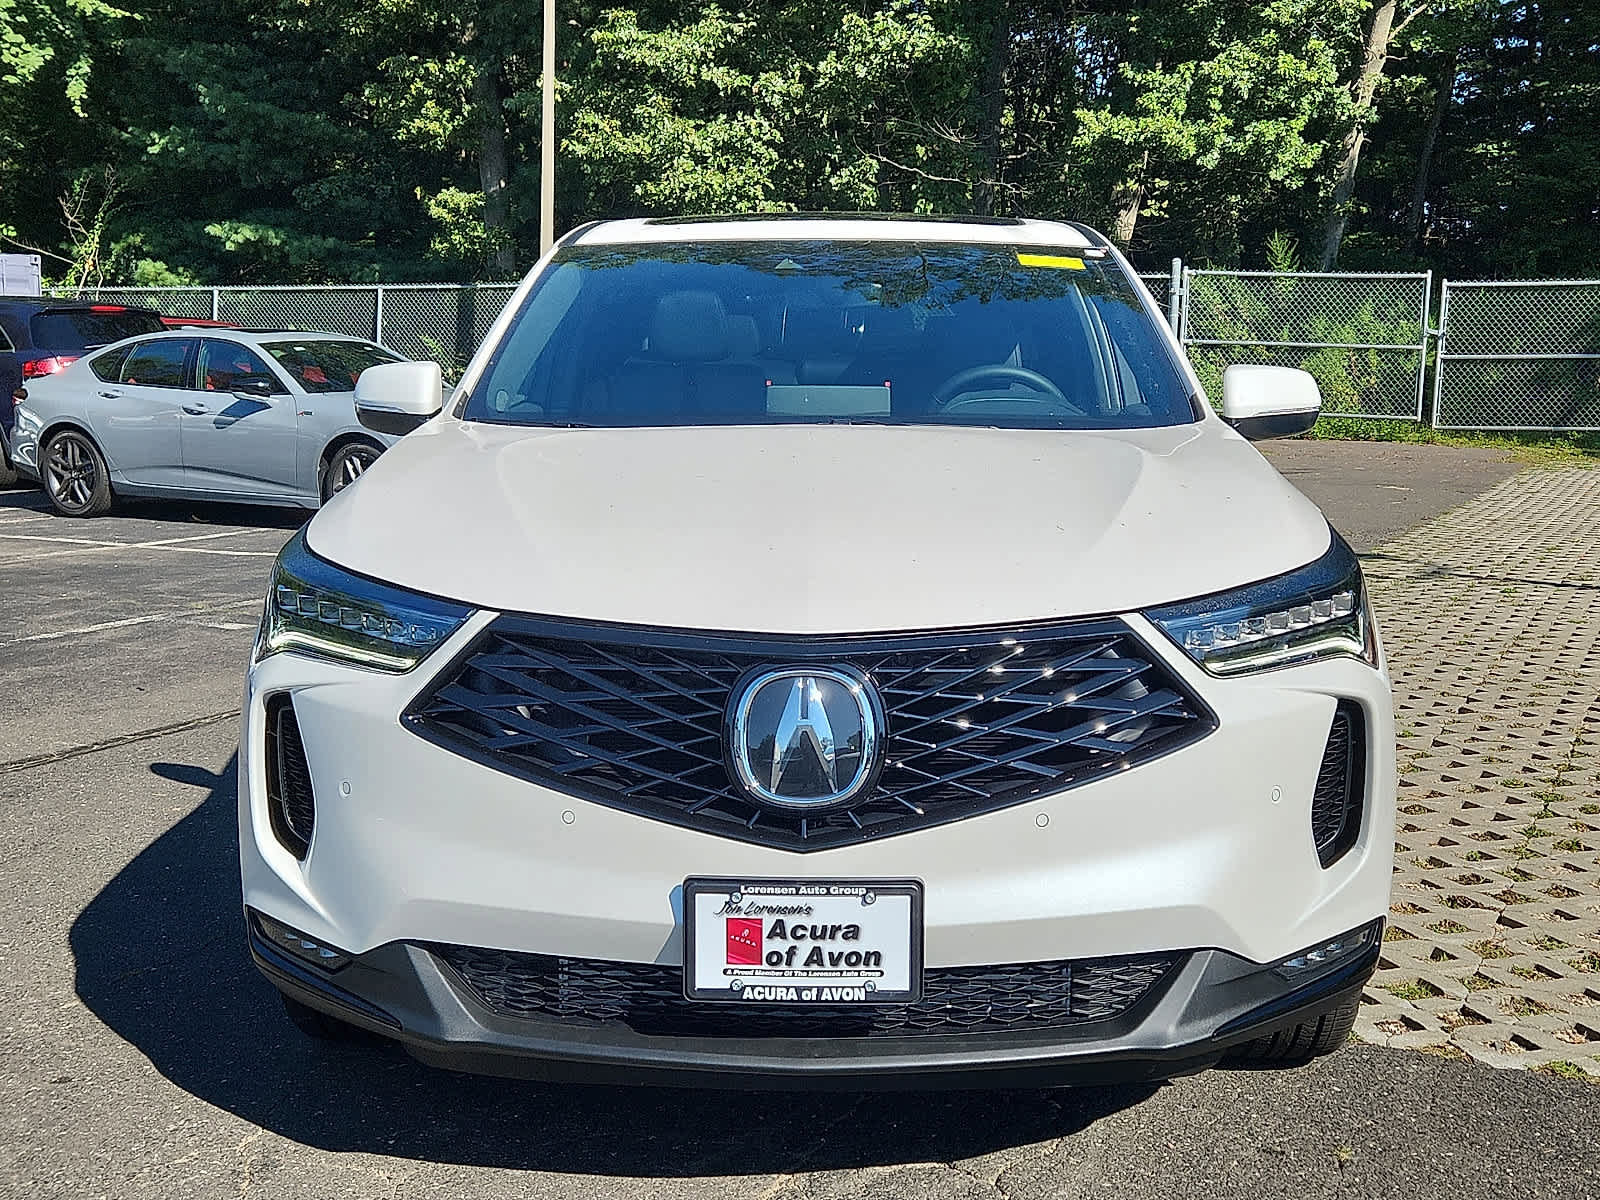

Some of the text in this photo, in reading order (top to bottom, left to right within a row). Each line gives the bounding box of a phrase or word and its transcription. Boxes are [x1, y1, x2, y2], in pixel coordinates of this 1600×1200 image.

[740, 885, 867, 897] Lorensen Auto Group
[766, 918, 860, 941] Acura
[765, 945, 882, 967] of Avon
[742, 986, 866, 1001] ACURA of AVON
